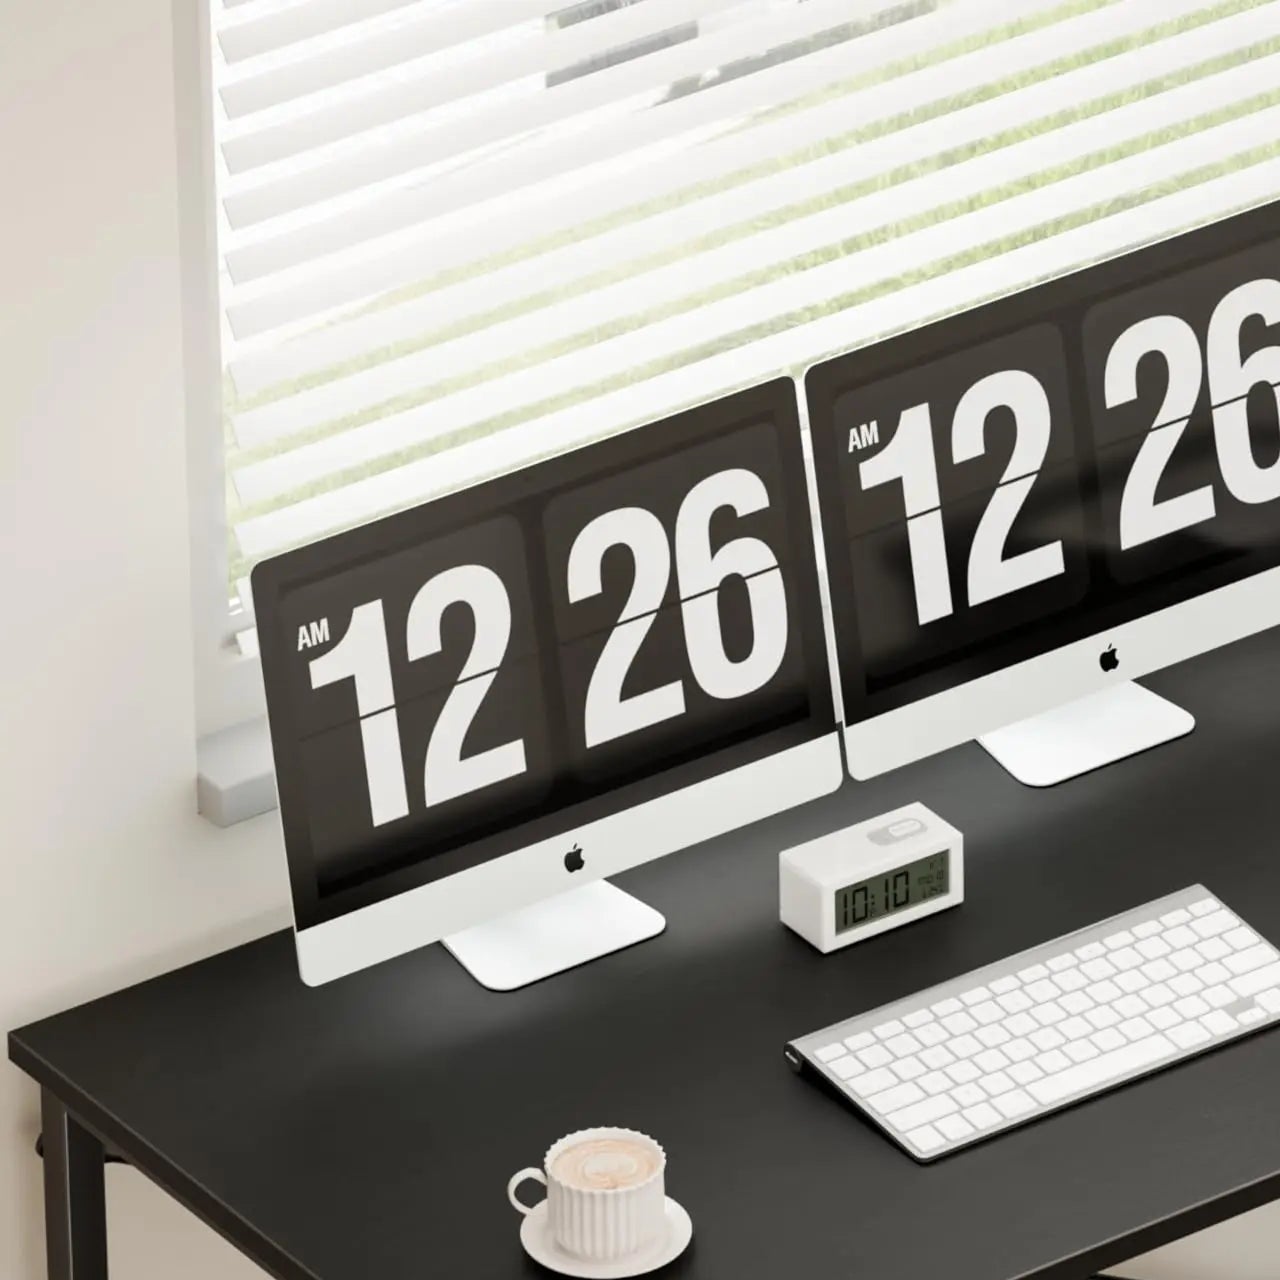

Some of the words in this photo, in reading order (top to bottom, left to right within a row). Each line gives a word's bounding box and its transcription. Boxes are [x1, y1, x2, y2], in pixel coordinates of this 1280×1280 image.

[847, 419, 880, 454] AM
[858, 369, 1066, 627] 12
[296, 616, 331, 653] AM
[566, 468, 788, 750] 26
[307, 564, 527, 828] 12
[843, 870, 910, 927] 10:10
